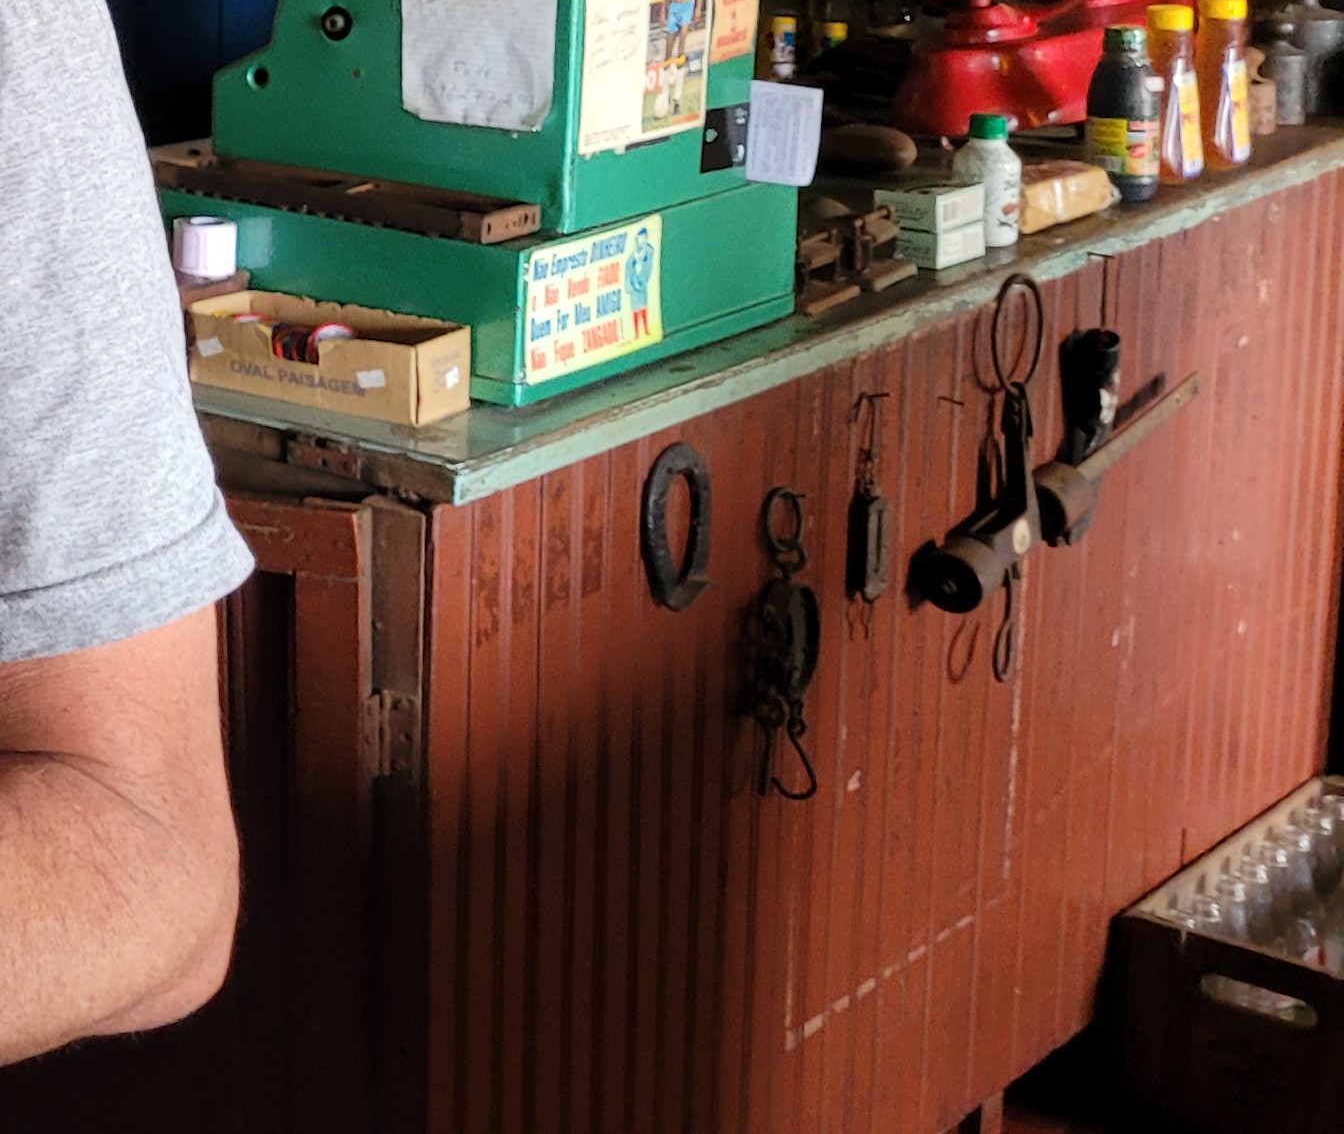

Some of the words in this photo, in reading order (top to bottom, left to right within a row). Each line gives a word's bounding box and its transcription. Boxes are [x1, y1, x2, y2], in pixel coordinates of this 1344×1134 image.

[533, 258, 549, 281] Não
[531, 347, 547, 371] Não
[230, 359, 272, 381] OVAL
[278, 369, 366, 397] PAISAGEM
